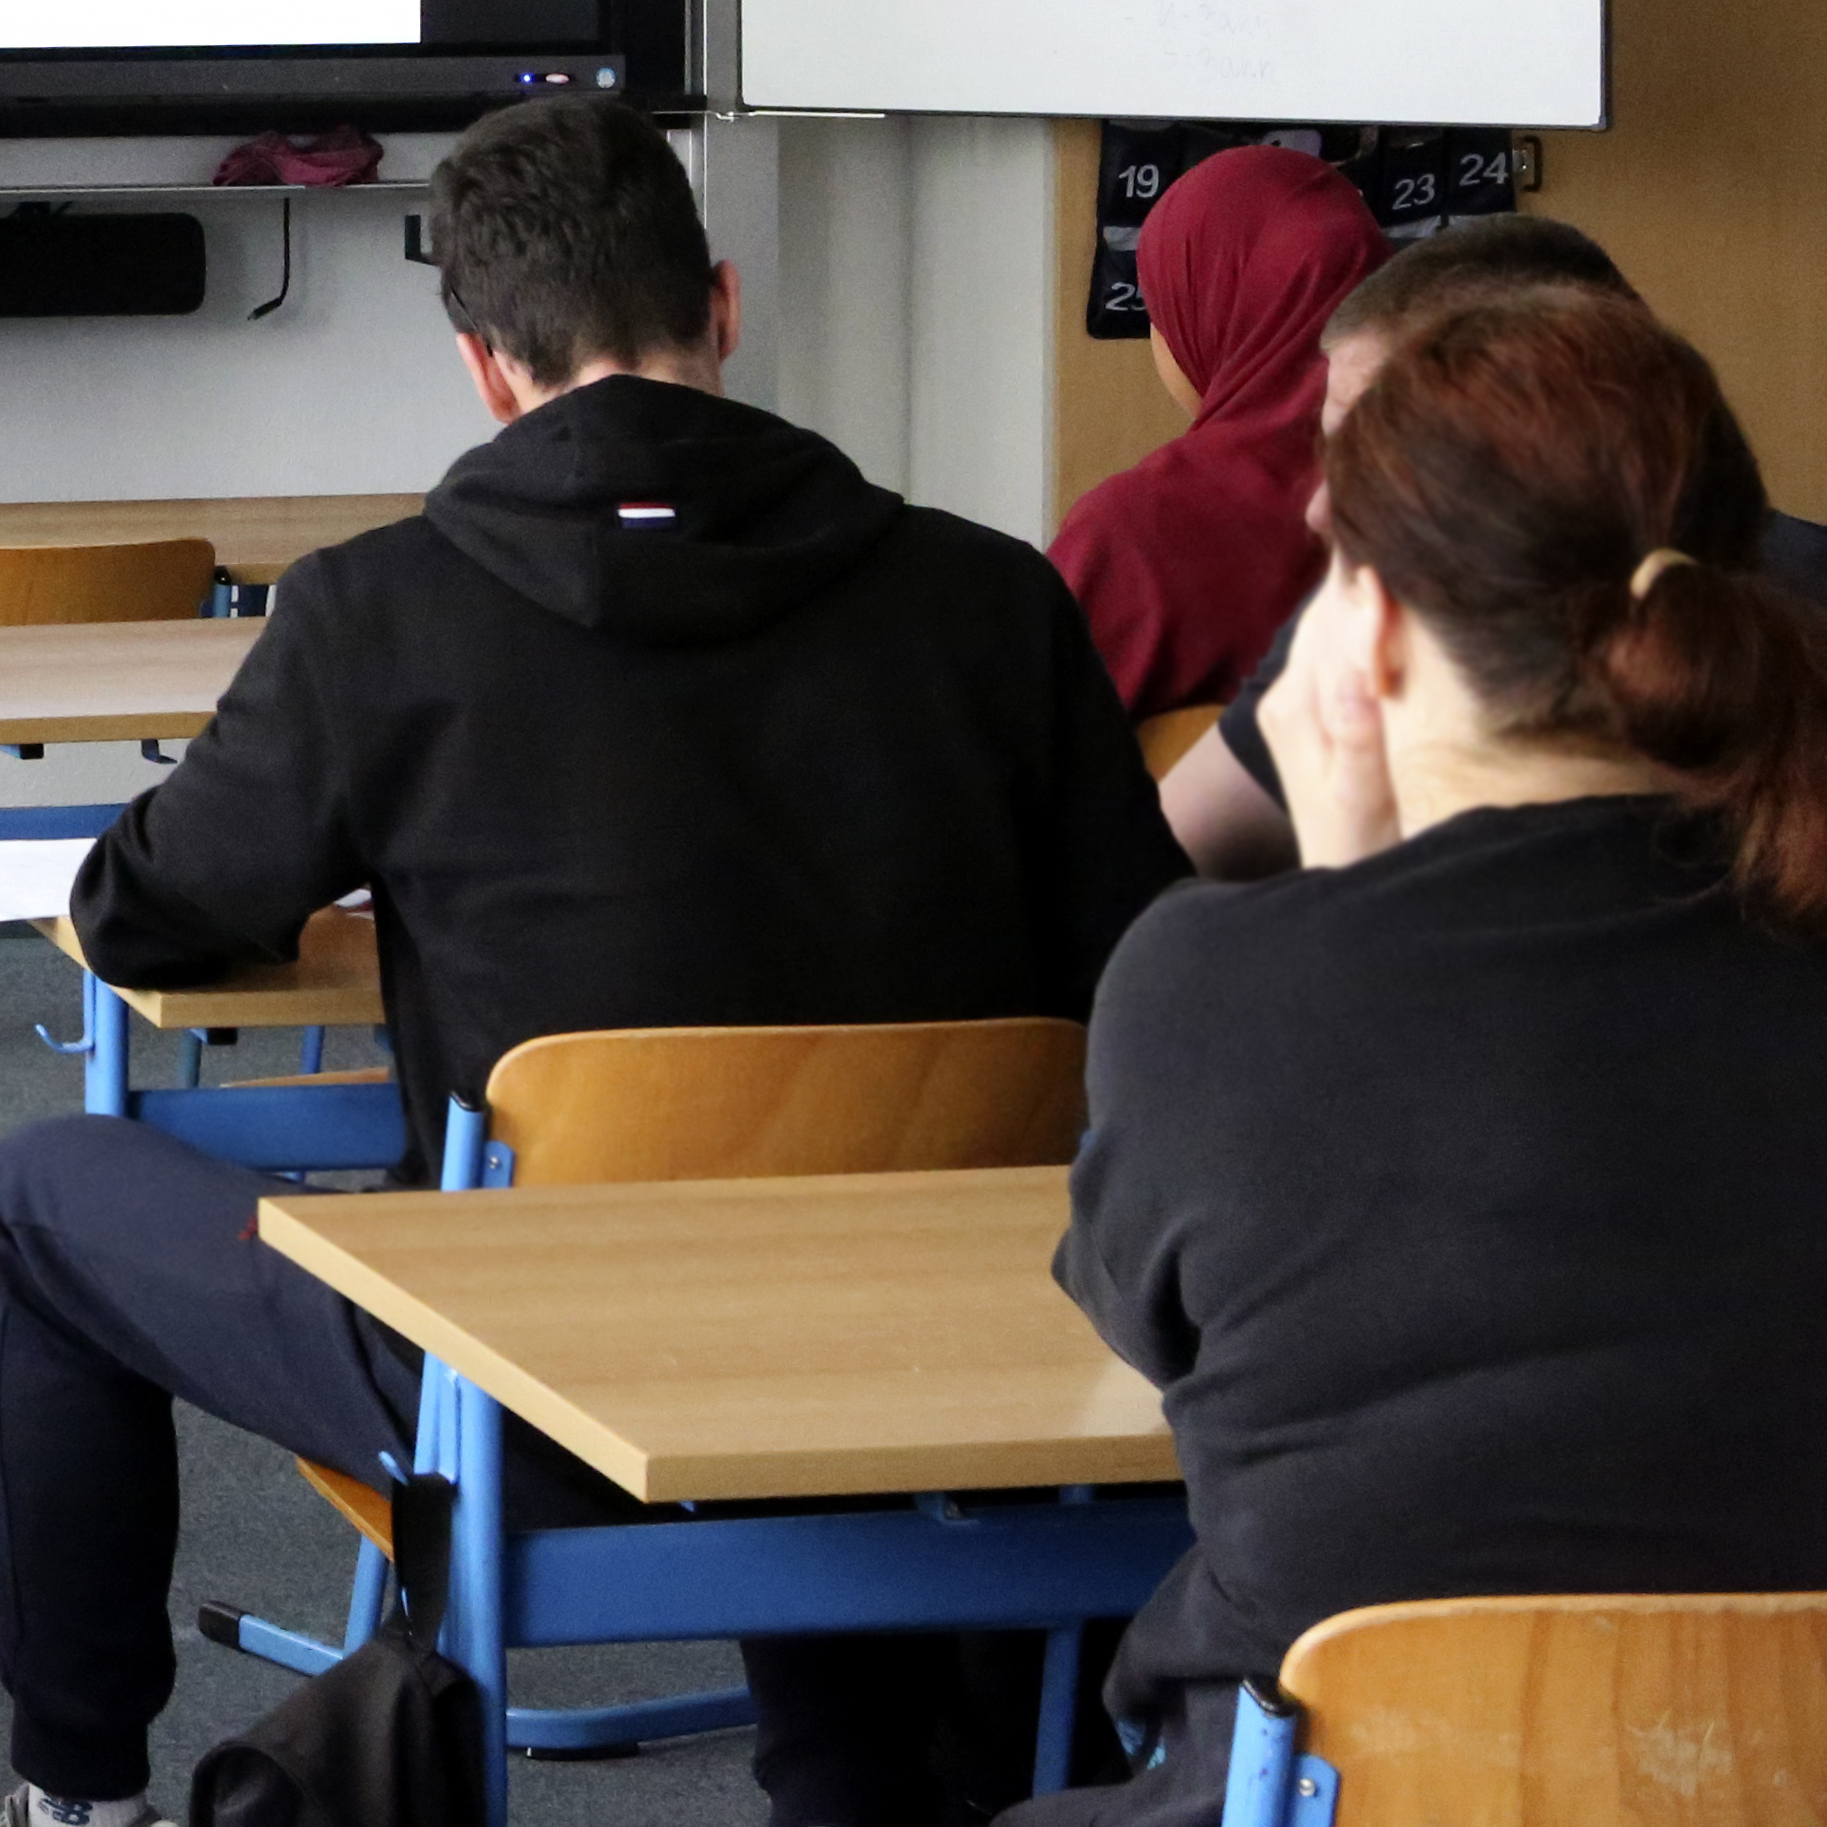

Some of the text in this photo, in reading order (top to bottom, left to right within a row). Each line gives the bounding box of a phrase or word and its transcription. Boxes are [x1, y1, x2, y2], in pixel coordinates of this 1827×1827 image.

[1118, 163, 1160, 198] 19
[1458, 152, 1508, 186] 24
[1392, 174, 1436, 210] 23
